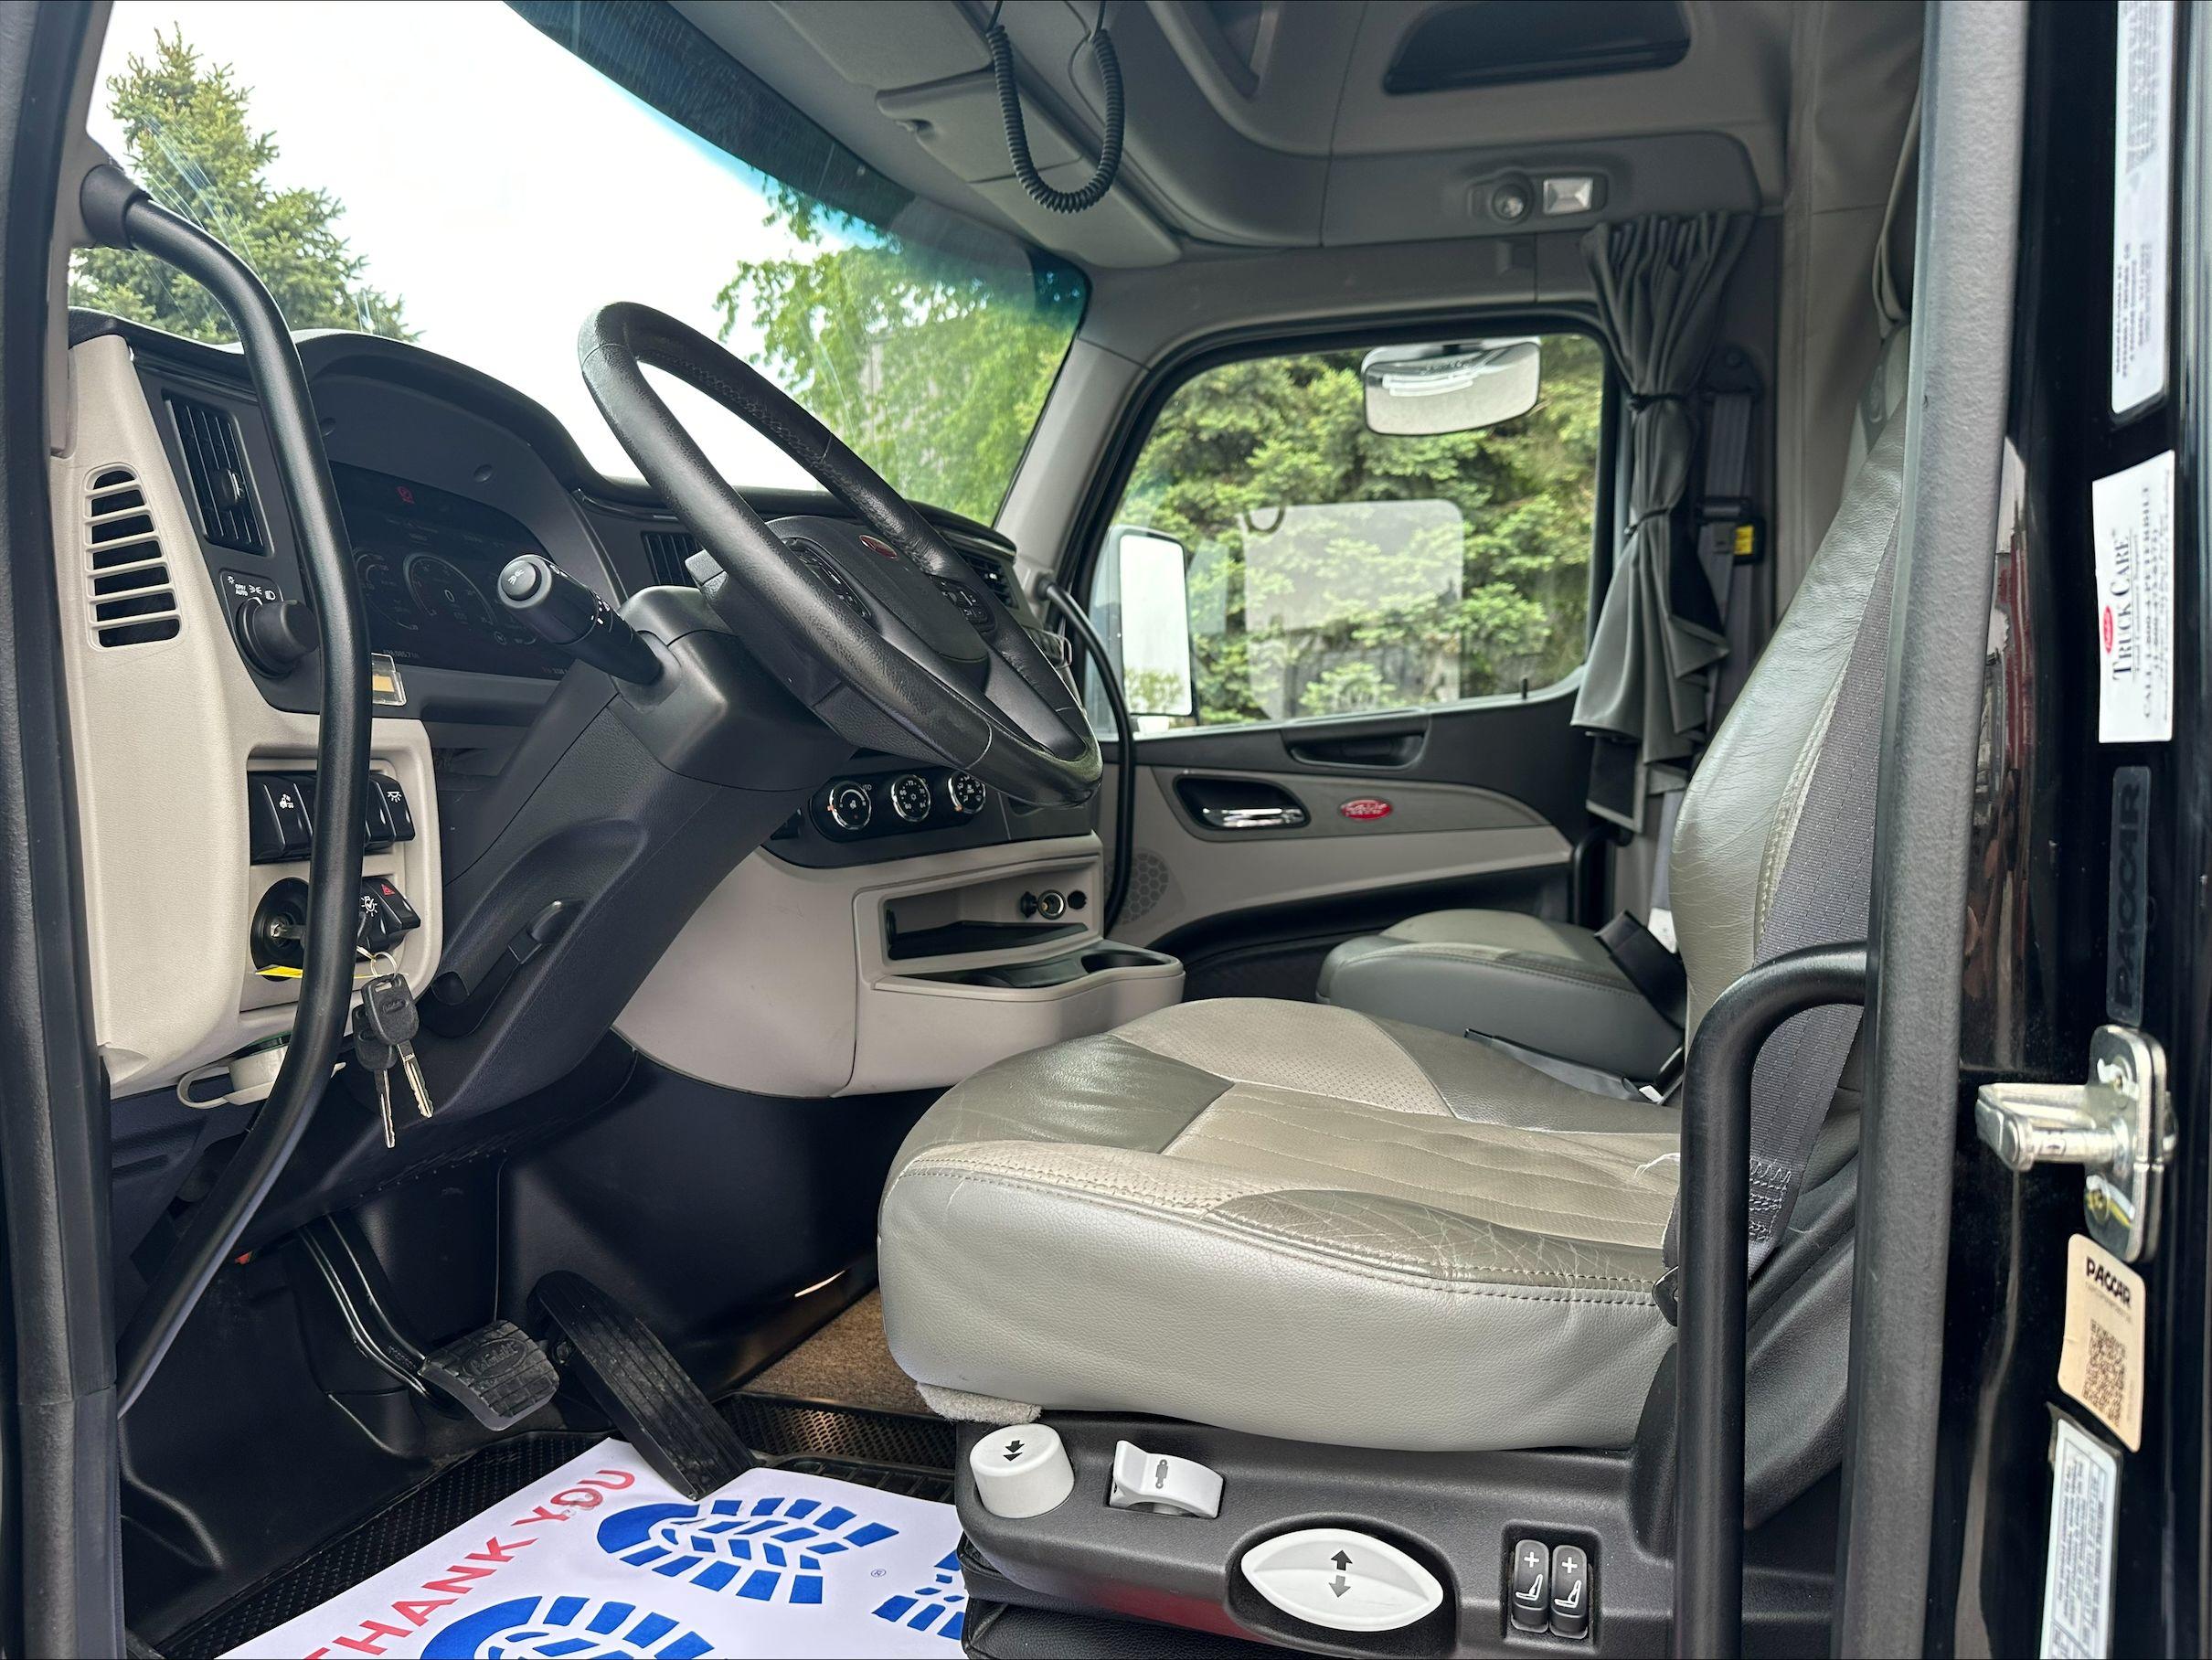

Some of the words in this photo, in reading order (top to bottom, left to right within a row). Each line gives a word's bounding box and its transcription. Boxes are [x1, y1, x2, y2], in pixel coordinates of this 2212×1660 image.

[2110, 536, 2131, 596] CARE
[2111, 601, 2132, 680] TRUCK
[2114, 783, 2140, 1006] PACCAR
[2086, 1256, 2132, 1307] PACCAR
[511, 1469, 635, 1526] YOU
